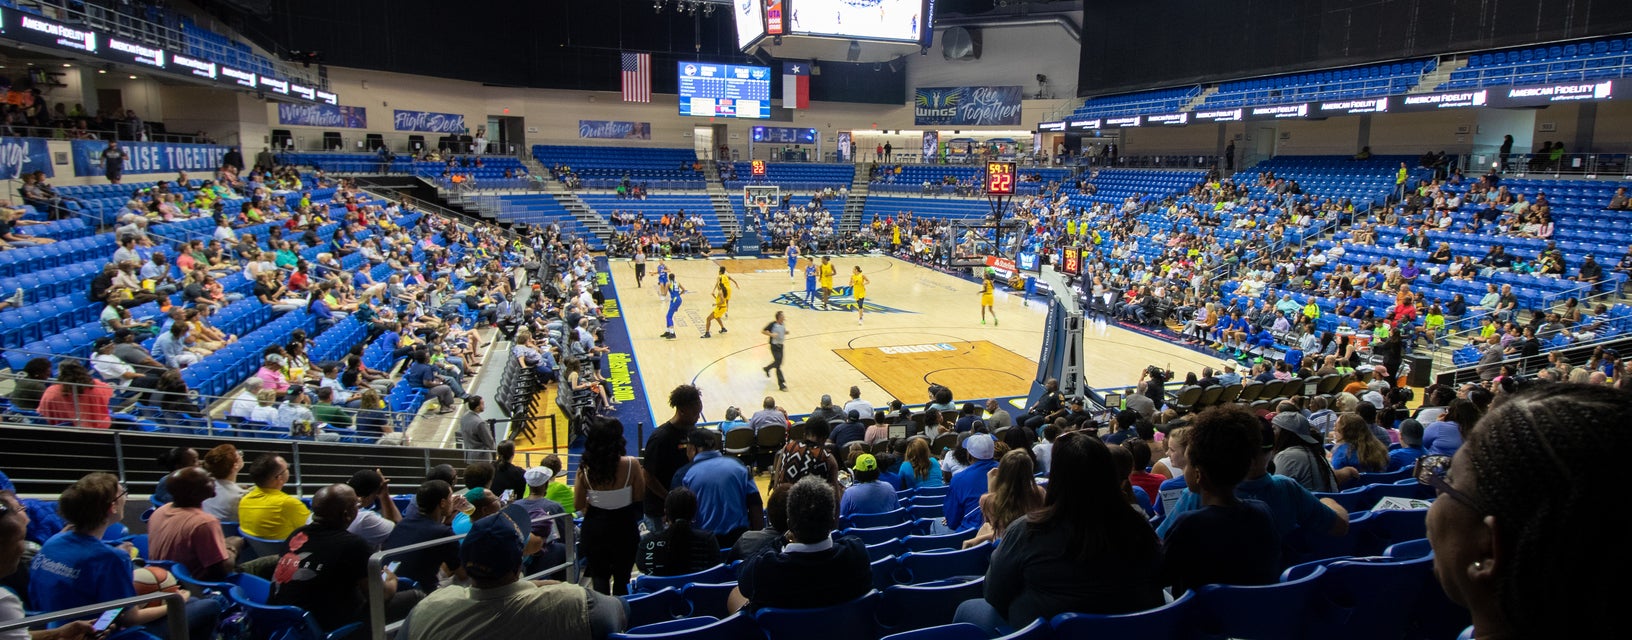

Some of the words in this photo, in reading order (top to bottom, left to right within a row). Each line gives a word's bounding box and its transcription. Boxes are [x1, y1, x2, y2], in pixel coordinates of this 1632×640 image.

[22, 16, 58, 35] AMERICAN
[59, 25, 85, 41] FIDELITY
[972, 88, 998, 104] Rise
[1404, 96, 1440, 104] AMERICAN
[1441, 93, 1472, 102] FIDELITY
[1508, 88, 1553, 98] AMERICAN
[1554, 84, 1594, 94] FIDELITY
[916, 107, 956, 116] WINGS
[1322, 102, 1350, 110] AMERICAN
[1350, 100, 1376, 108] FIDELITY
[962, 102, 1020, 125] Together
[395, 112, 428, 130] Flight
[427, 115, 464, 132] Deck
[124, 146, 160, 170] RISE
[990, 164, 1008, 173] 59.7
[992, 174, 1010, 190] 22
[1067, 260, 1076, 270] 22
